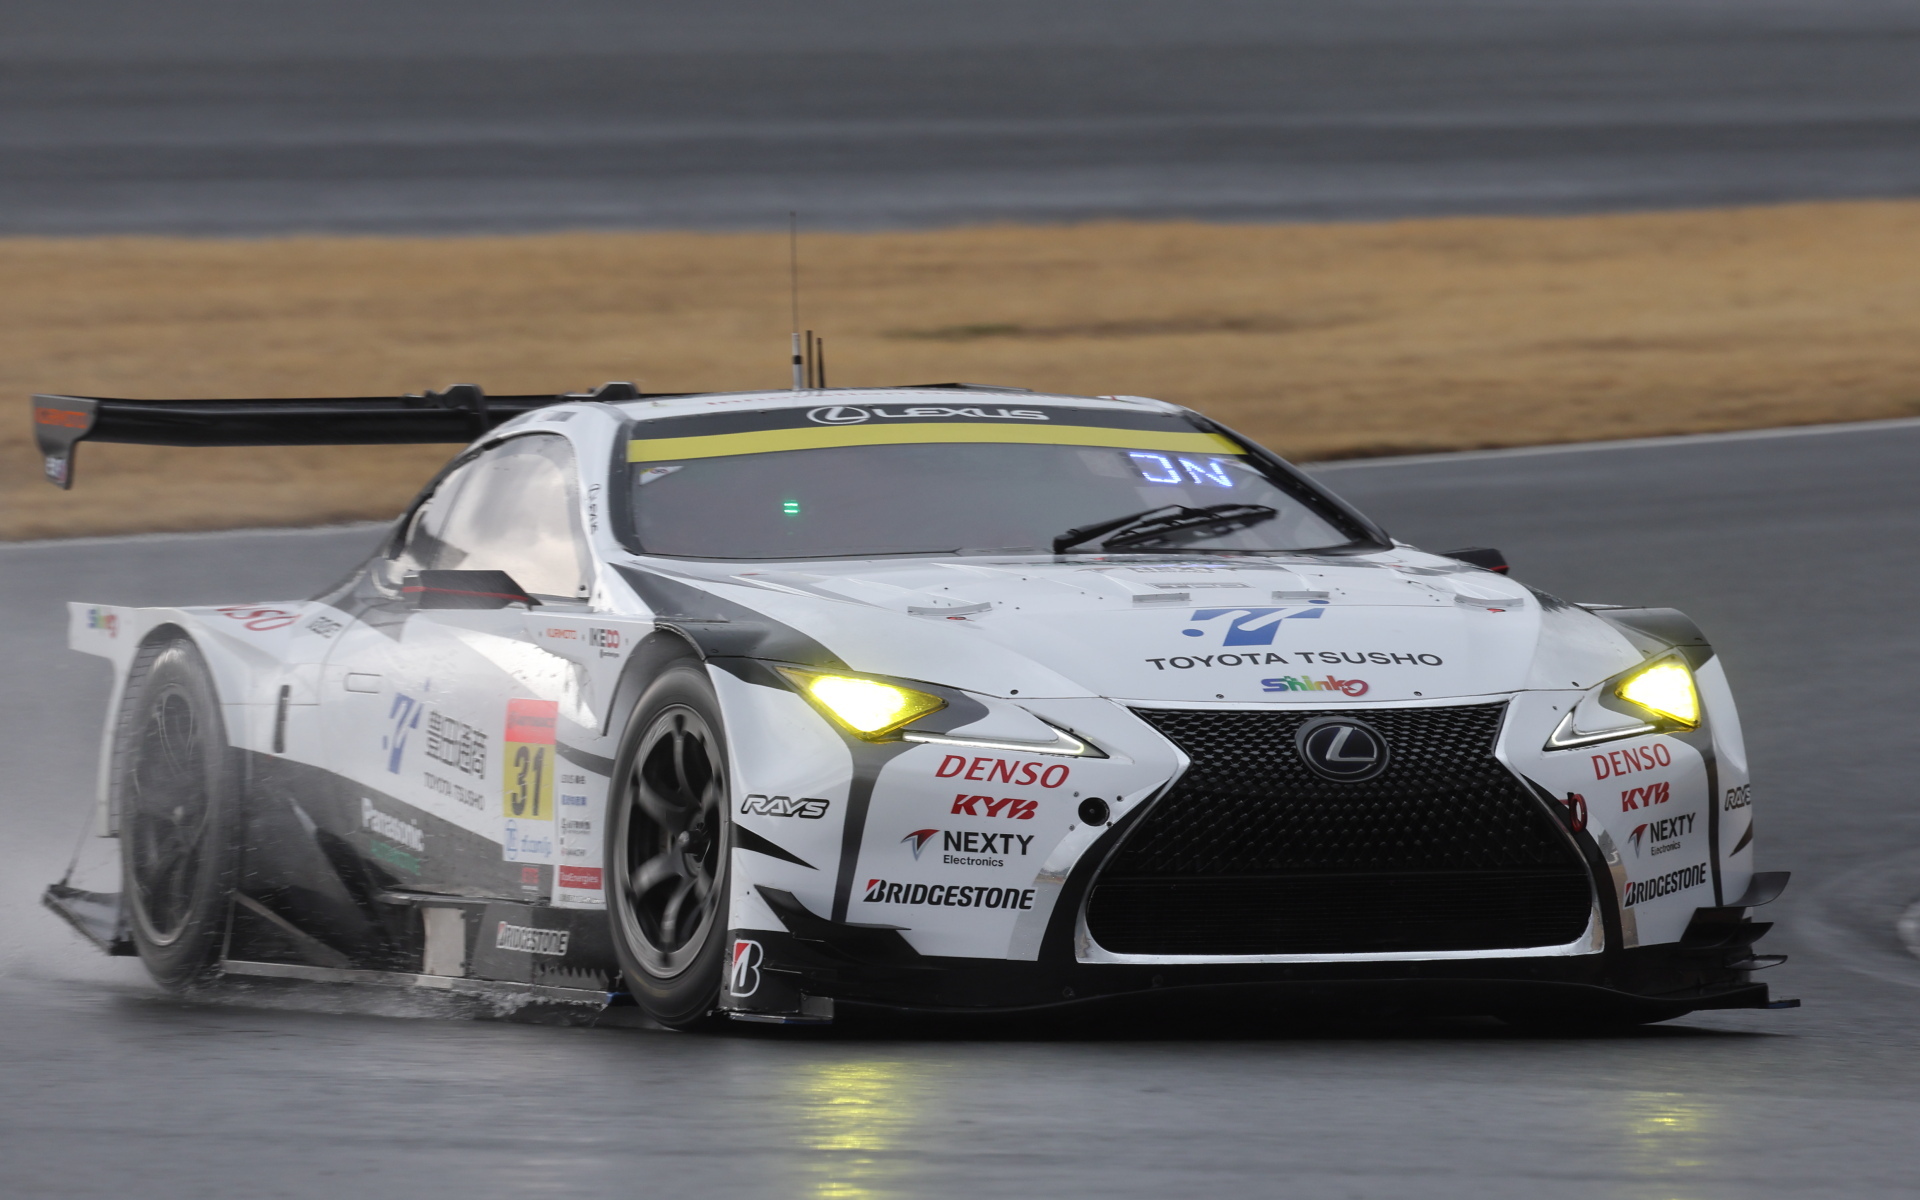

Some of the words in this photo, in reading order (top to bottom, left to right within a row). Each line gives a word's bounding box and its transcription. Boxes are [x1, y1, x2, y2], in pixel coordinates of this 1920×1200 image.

[876, 408, 1049, 421] LEXUS
[1146, 652, 1289, 671] TOYOTA
[1299, 652, 1443, 667] TSUSHO
[1261, 675, 1369, 697] Shinko
[935, 755, 1070, 789] DENSO
[1591, 743, 1671, 780] DENSO
[511, 745, 545, 816] 31
[740, 794, 830, 819] RAYS
[951, 794, 1038, 820] KYB
[1621, 782, 1670, 812] KYB
[1650, 812, 1696, 843] NEXTY
[943, 831, 1035, 856] NEXTY
[1650, 841, 1681, 857] Electronics
[943, 854, 1004, 868] Electronics
[863, 878, 1036, 910] BRIDGESTONE
[1624, 862, 1707, 907] BRIDGESTONE
